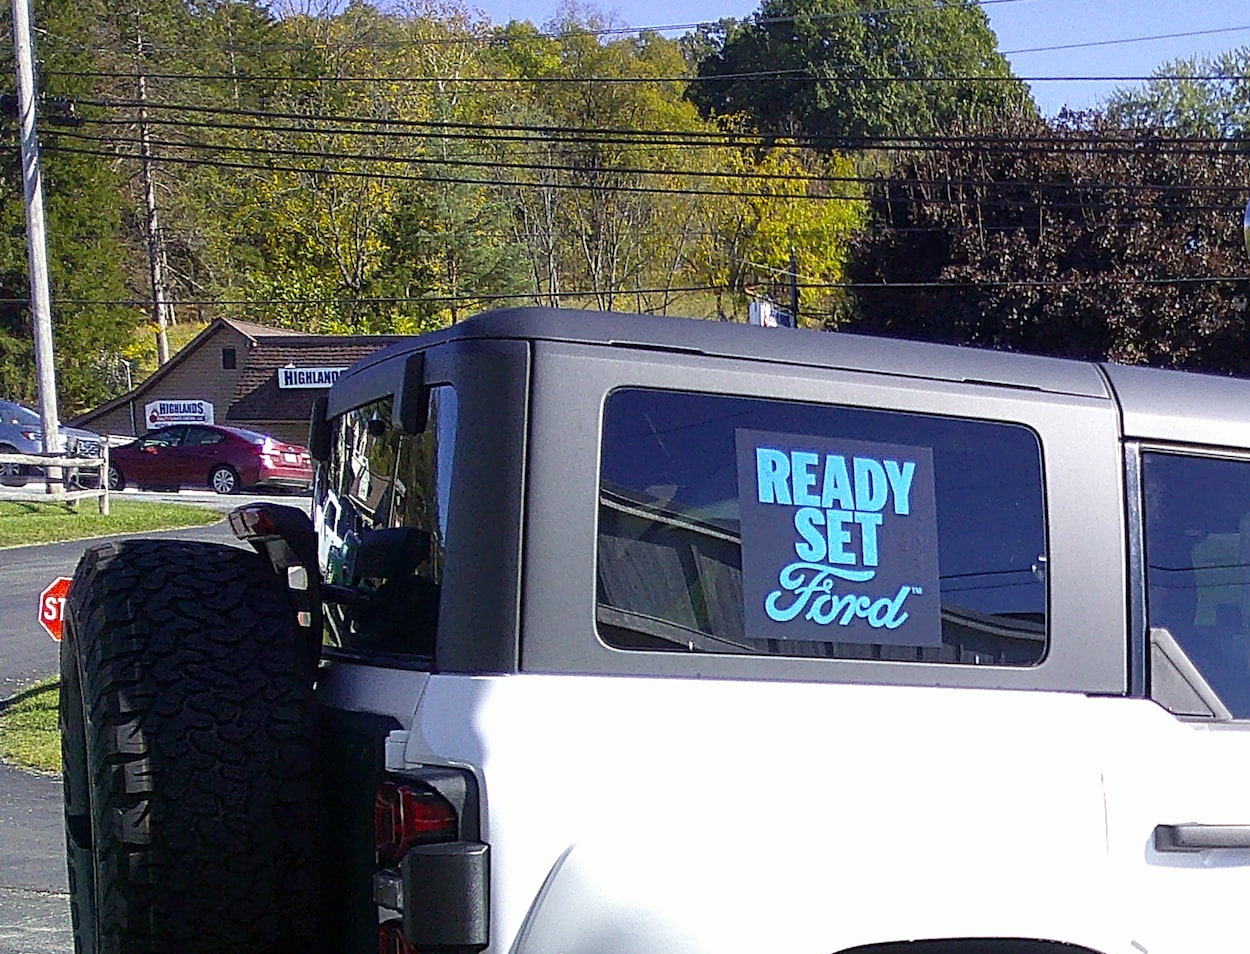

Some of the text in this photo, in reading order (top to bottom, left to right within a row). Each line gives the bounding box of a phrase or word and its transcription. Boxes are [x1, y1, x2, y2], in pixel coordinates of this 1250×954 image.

[284, 370, 346, 386] HIGHLAND
[159, 402, 204, 415] HIGHLANDS
[756, 448, 915, 515] READY
[794, 506, 883, 567] SET
[43, 596, 66, 621] ST
